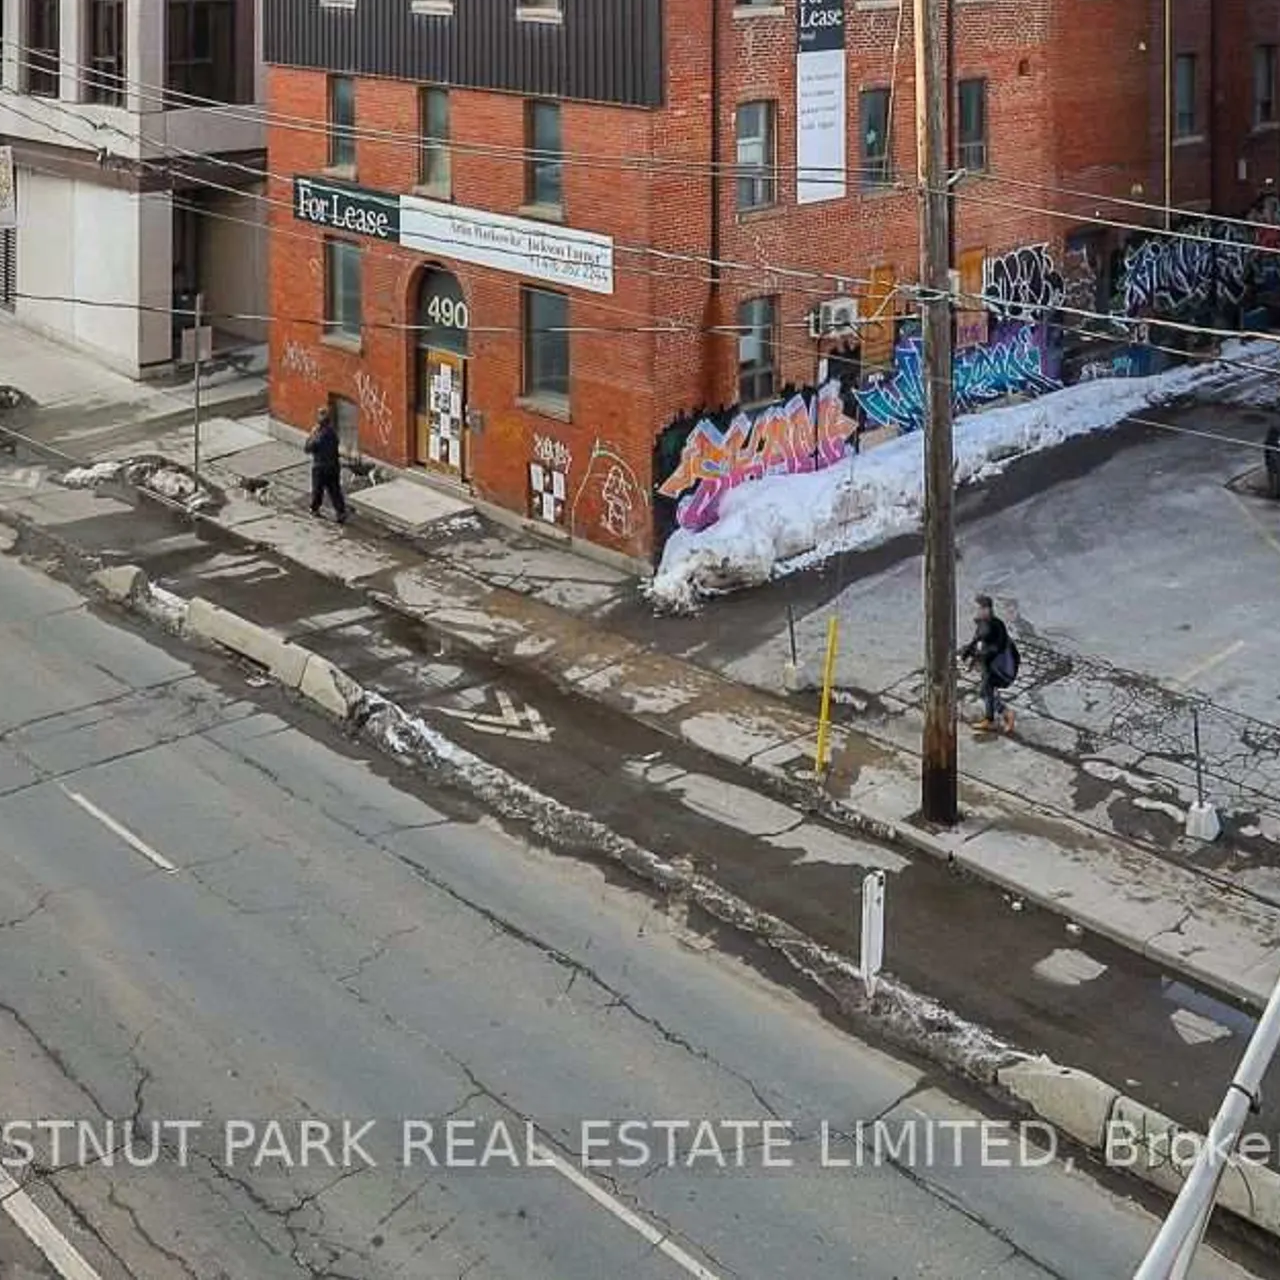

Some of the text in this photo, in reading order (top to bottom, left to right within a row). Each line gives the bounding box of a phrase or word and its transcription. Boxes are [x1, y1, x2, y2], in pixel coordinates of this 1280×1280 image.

[800, 6, 843, 28] Lease
[298, 186, 388, 237] For Lease
[427, 295, 468, 329] 490
